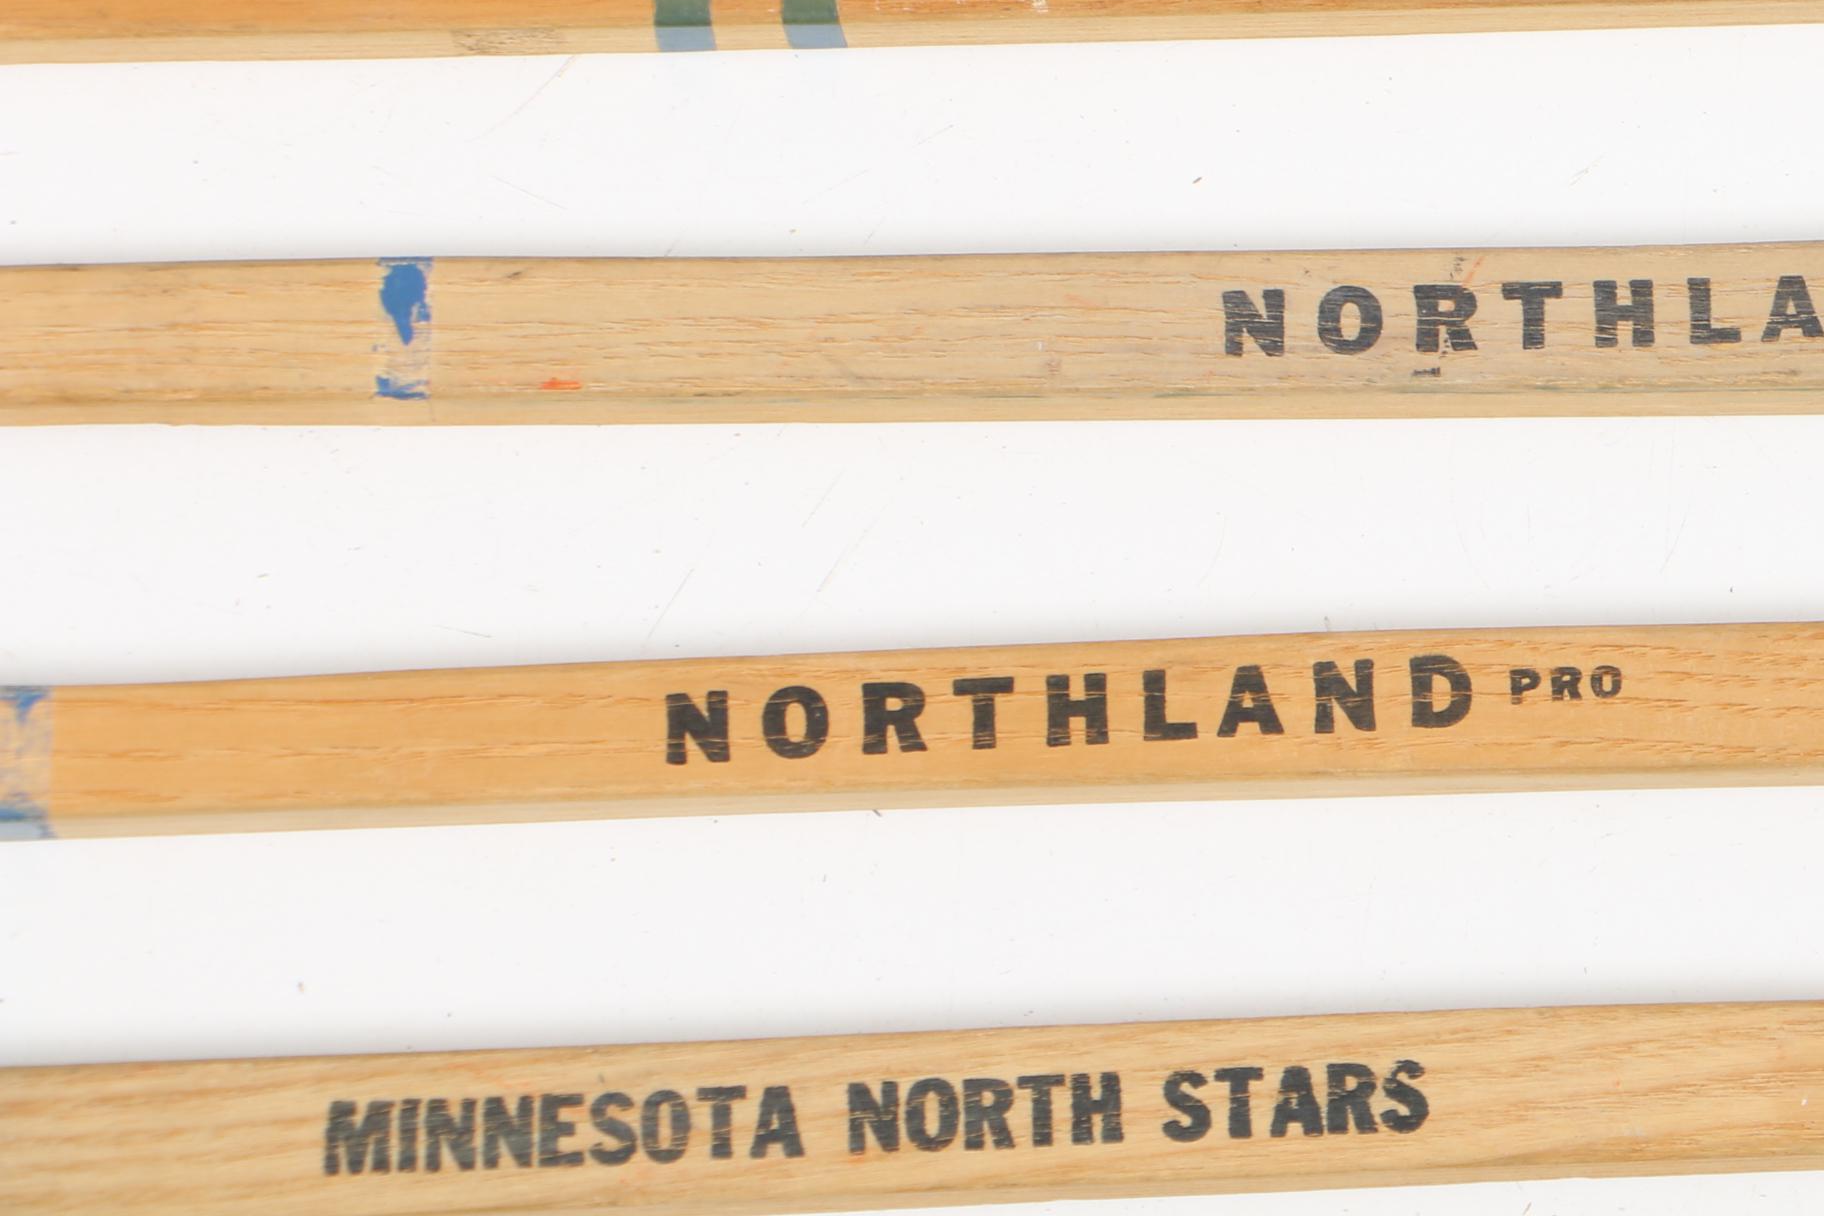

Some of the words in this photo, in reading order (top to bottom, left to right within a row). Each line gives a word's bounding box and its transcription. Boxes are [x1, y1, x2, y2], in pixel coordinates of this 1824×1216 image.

[666, 655, 1473, 765] NORTHLAND
[1510, 665, 1622, 704] PRO
[324, 1085, 804, 1175] MINNESOTA
[847, 1072, 1124, 1152] NORTH
[1162, 1059, 1430, 1142] STARS
